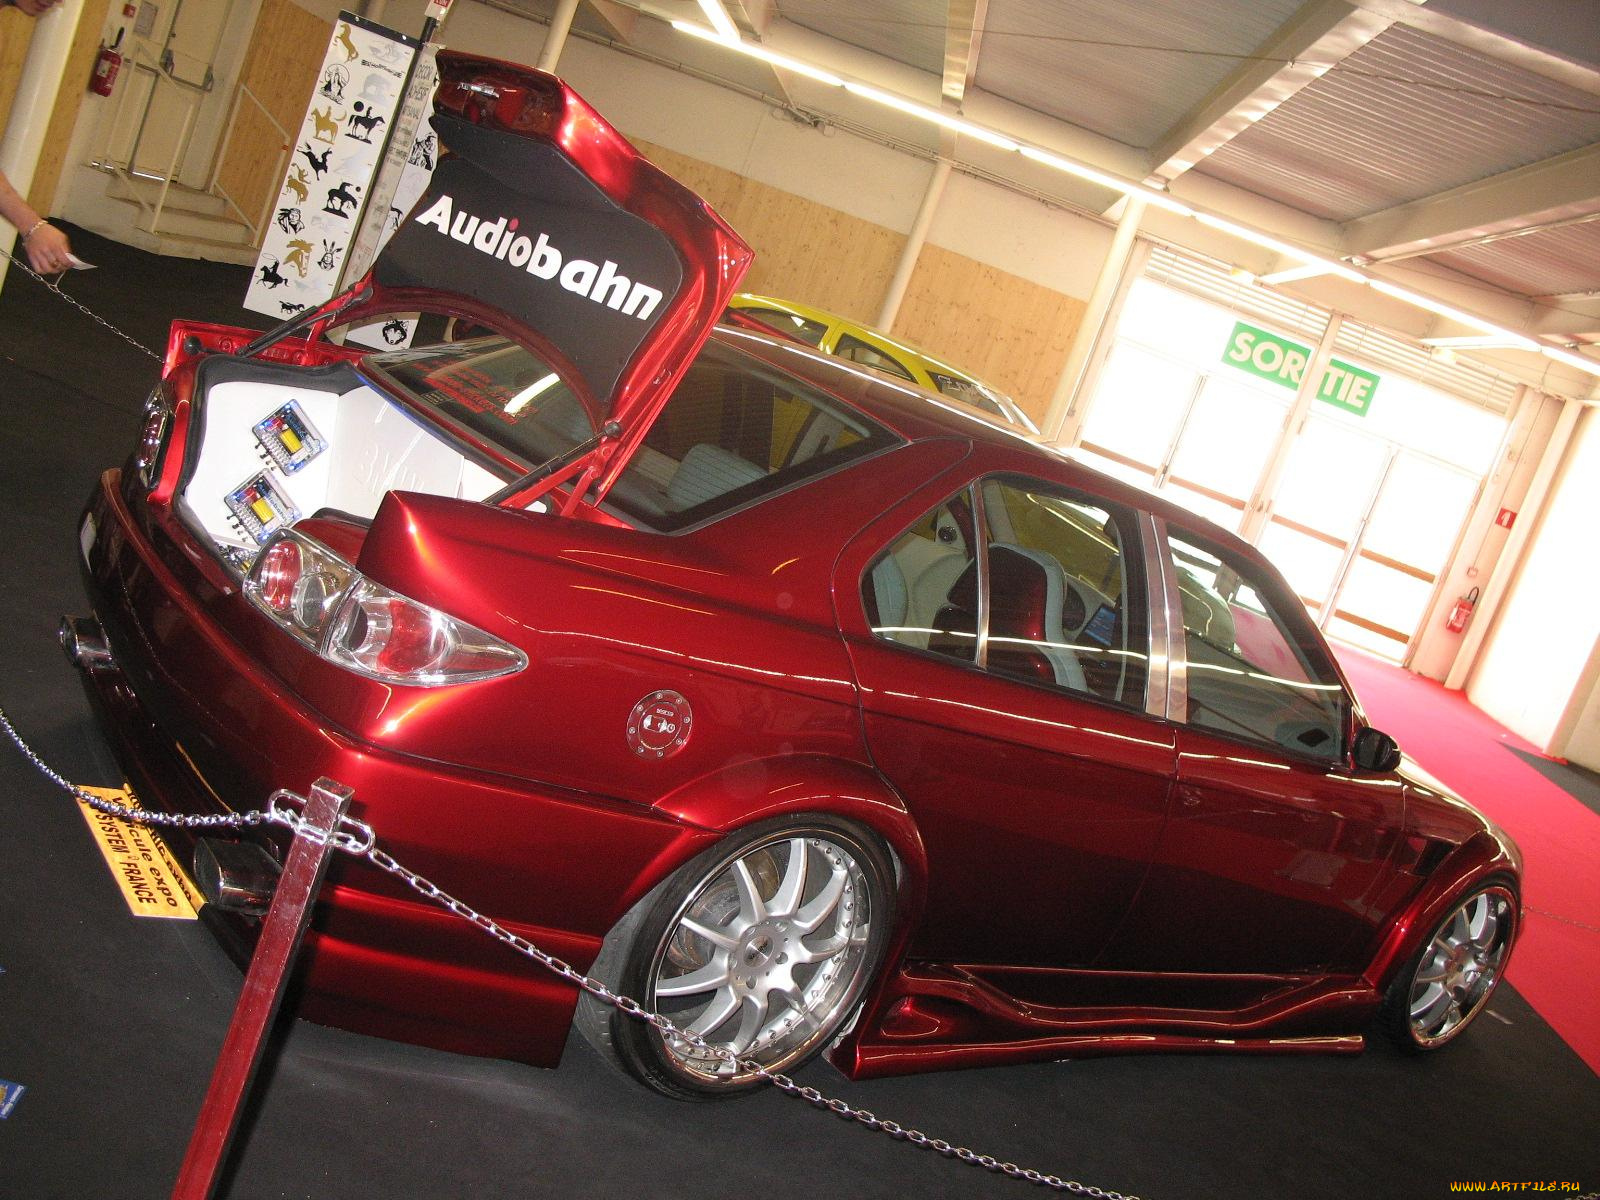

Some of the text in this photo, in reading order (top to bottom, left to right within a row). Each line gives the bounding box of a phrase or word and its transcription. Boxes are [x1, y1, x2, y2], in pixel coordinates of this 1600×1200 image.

[414, 194, 663, 321] Audiobahn
[95, 814, 158, 905] SYSTEM FRANCE
[150, 867, 178, 908] expo
